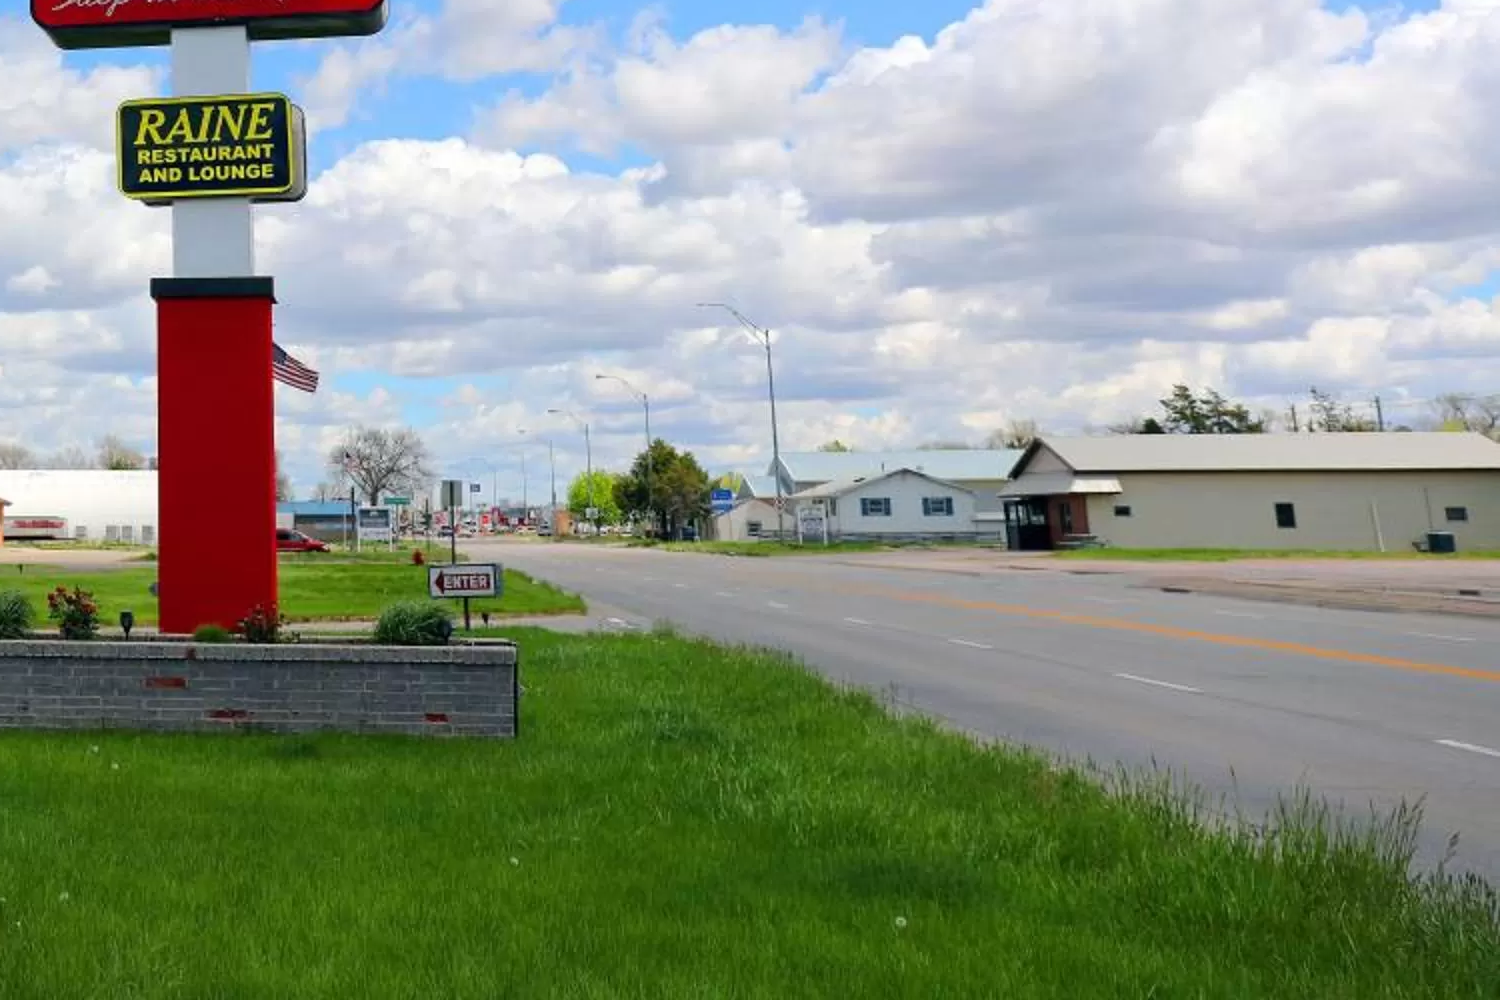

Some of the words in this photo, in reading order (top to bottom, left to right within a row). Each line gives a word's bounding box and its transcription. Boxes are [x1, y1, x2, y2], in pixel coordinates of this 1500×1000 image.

[133, 103, 275, 146] RAINE
[137, 143, 274, 165] RESTAURANT
[139, 166, 182, 183] AND
[188, 163, 275, 182] LOUNGE
[443, 575, 488, 589] ENTER
